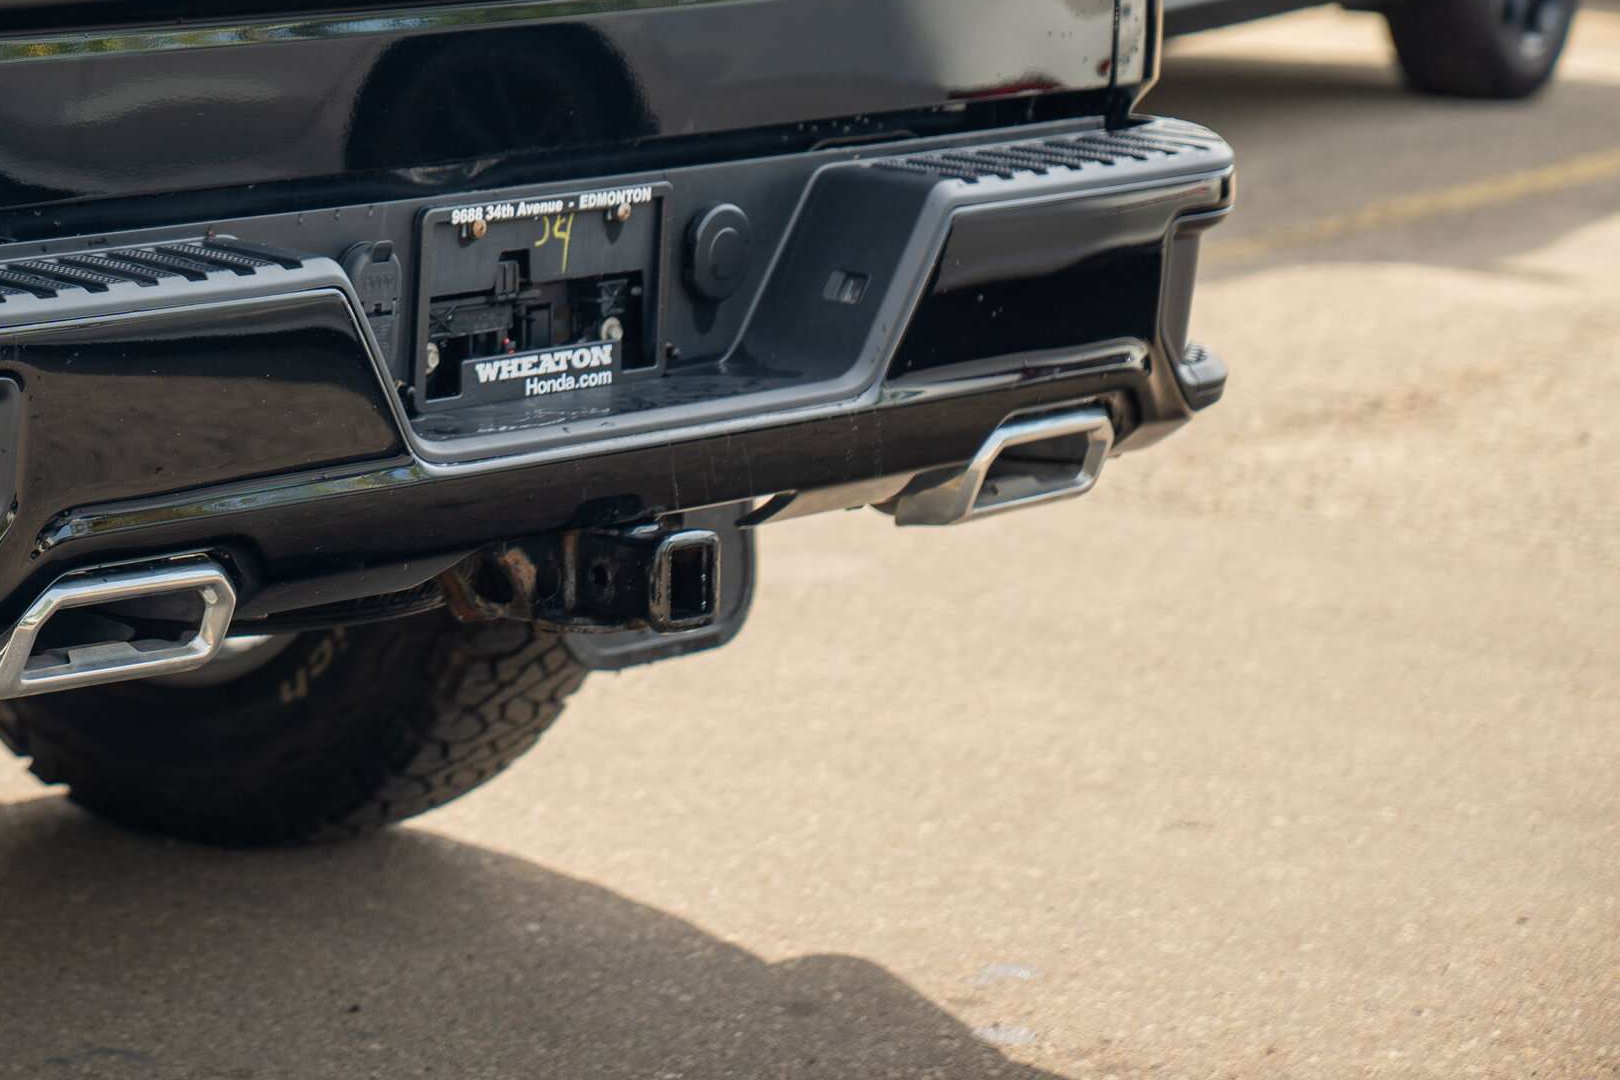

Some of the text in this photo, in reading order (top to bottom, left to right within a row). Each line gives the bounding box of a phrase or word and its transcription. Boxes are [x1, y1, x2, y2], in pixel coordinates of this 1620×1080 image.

[451, 186, 652, 224] 9688 34th Avenue EDMONTON
[475, 345, 613, 382] WHEATON
[525, 372, 613, 396] Honda.com
